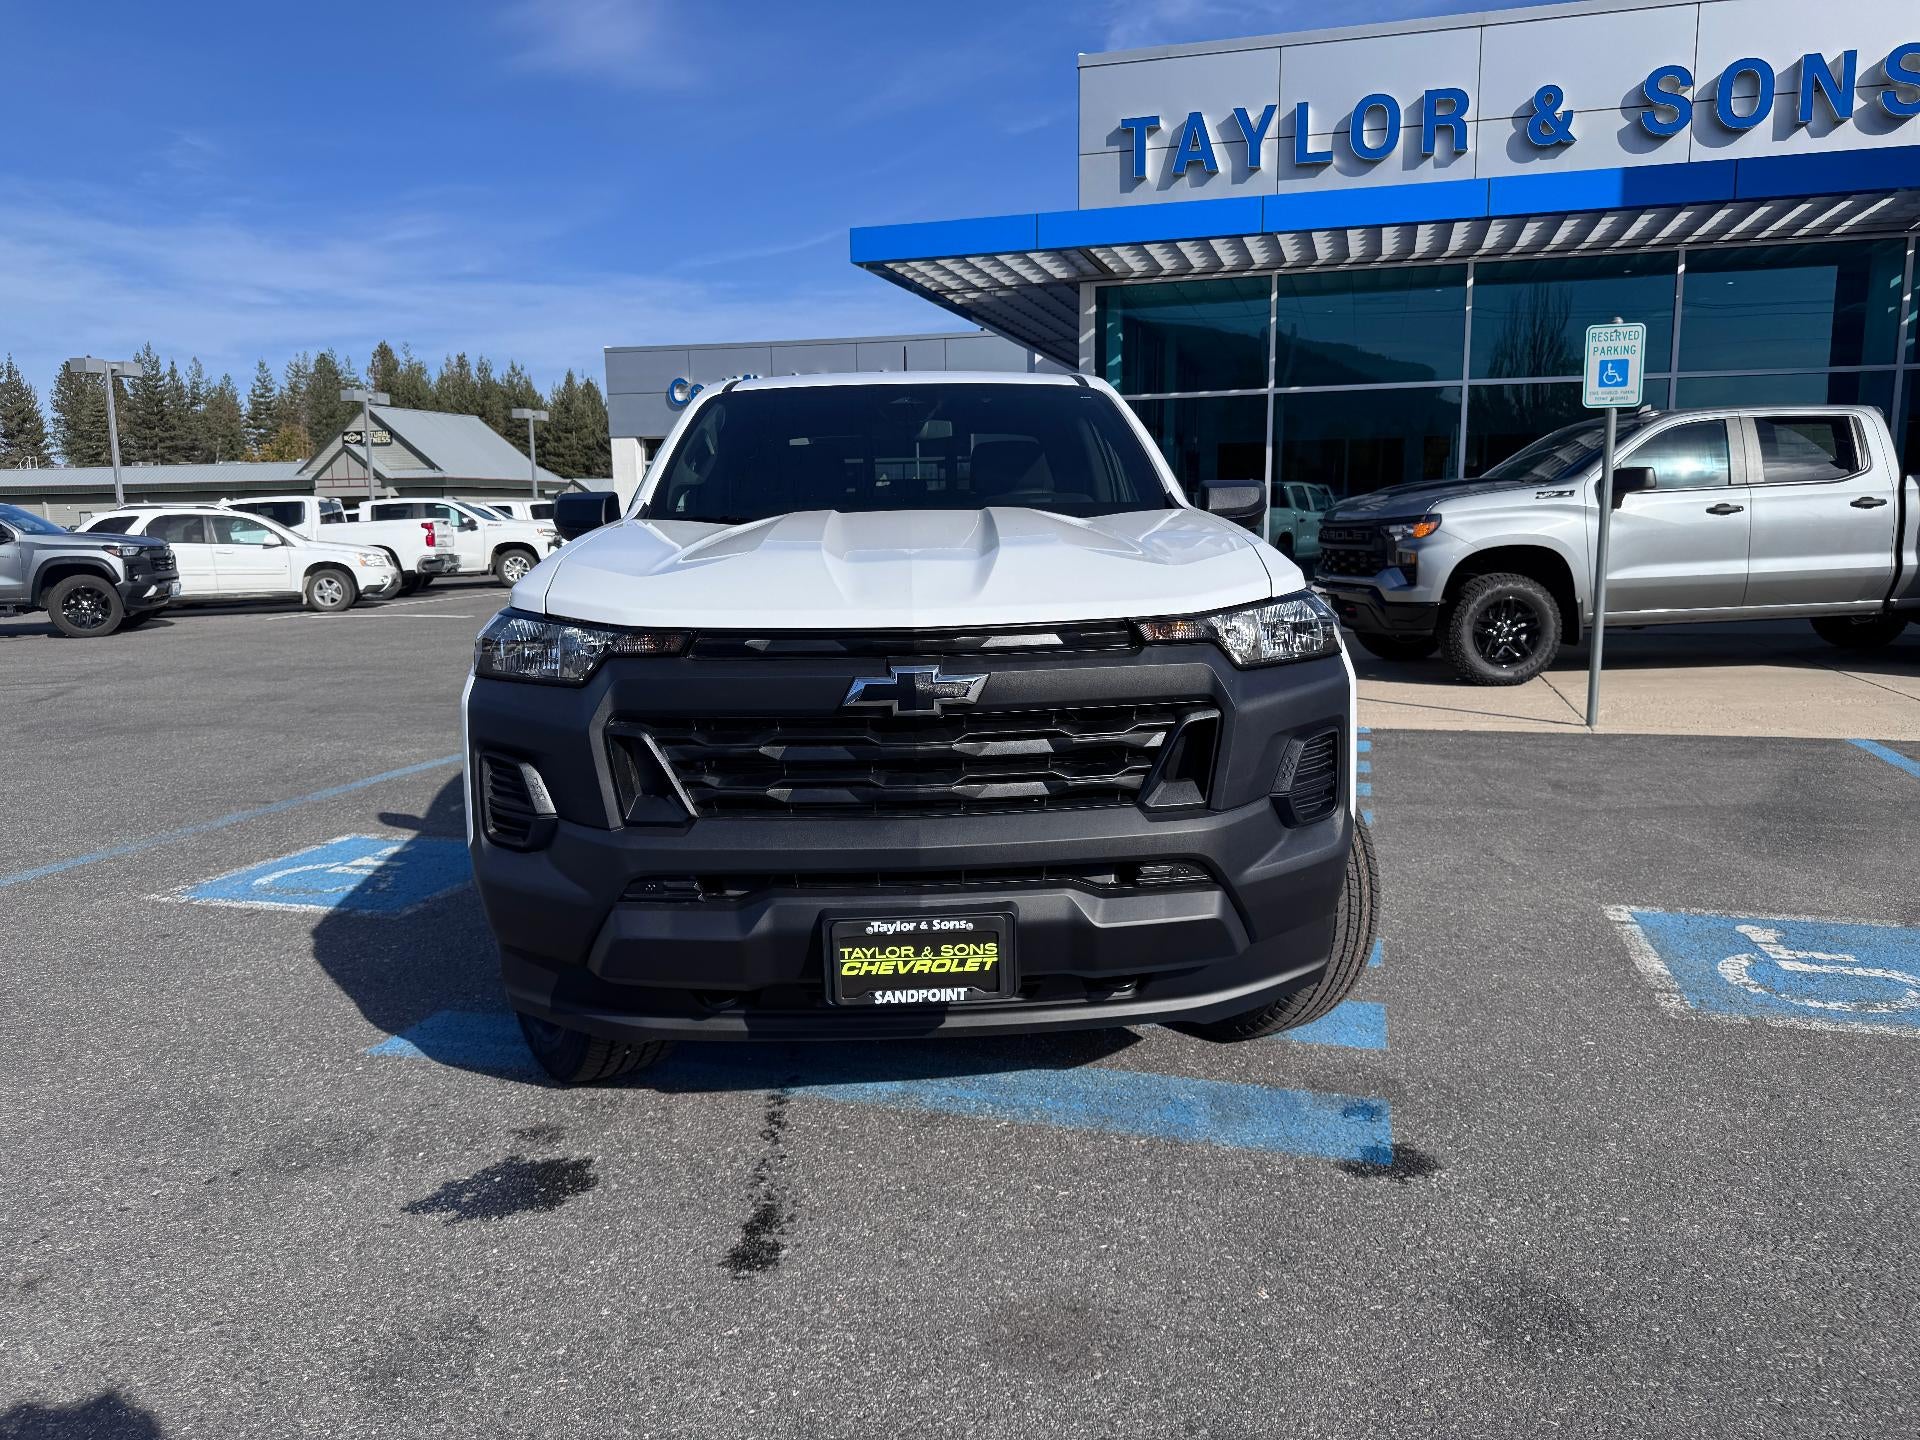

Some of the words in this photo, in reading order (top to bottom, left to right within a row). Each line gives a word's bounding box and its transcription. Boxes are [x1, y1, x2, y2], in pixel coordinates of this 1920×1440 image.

[1120, 86, 1470, 180] TAYLOR
[1526, 84, 1577, 147] &
[1640, 41, 1920, 138] SONS
[1591, 331, 1640, 342] RESERVED
[1593, 345, 1637, 356] PARKING
[870, 921, 916, 934] Taylor
[919, 921, 929, 930] &
[932, 919, 967, 930] Sons
[840, 946, 915, 960] TAYLOR
[921, 946, 934, 960] &
[940, 943, 998, 957] SONS
[841, 957, 998, 976] CHEVROLET
[874, 987, 968, 1004] SANDPOINT
